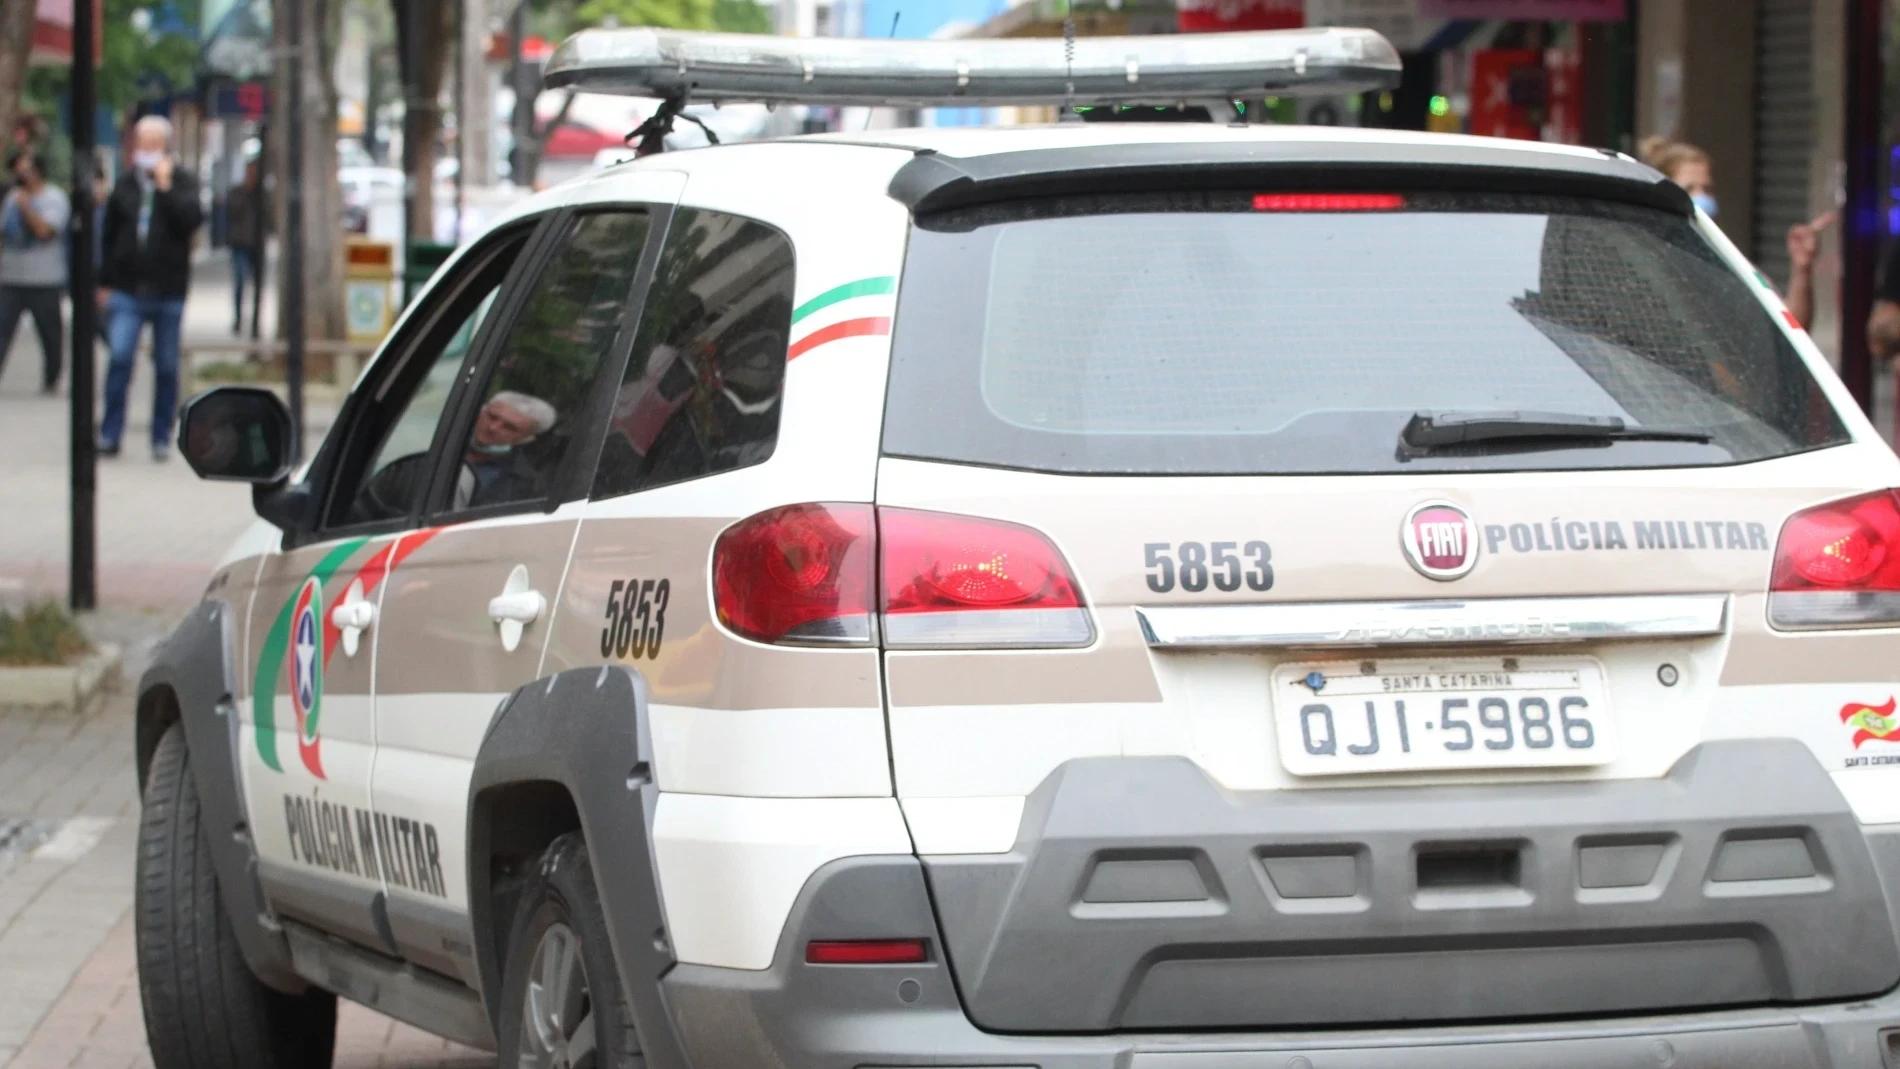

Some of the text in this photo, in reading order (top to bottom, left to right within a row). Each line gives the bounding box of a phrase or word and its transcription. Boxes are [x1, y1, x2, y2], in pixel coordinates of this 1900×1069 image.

[1419, 521, 1465, 557] FIAT
[1484, 517, 1770, 554] POLÍCIA MILITAR
[1143, 540, 1275, 594] 5853
[600, 578, 671, 661] 5853
[1381, 673, 1513, 691] SANTA CATARINA
[284, 785, 448, 899] POLÍCIA MILITAR
